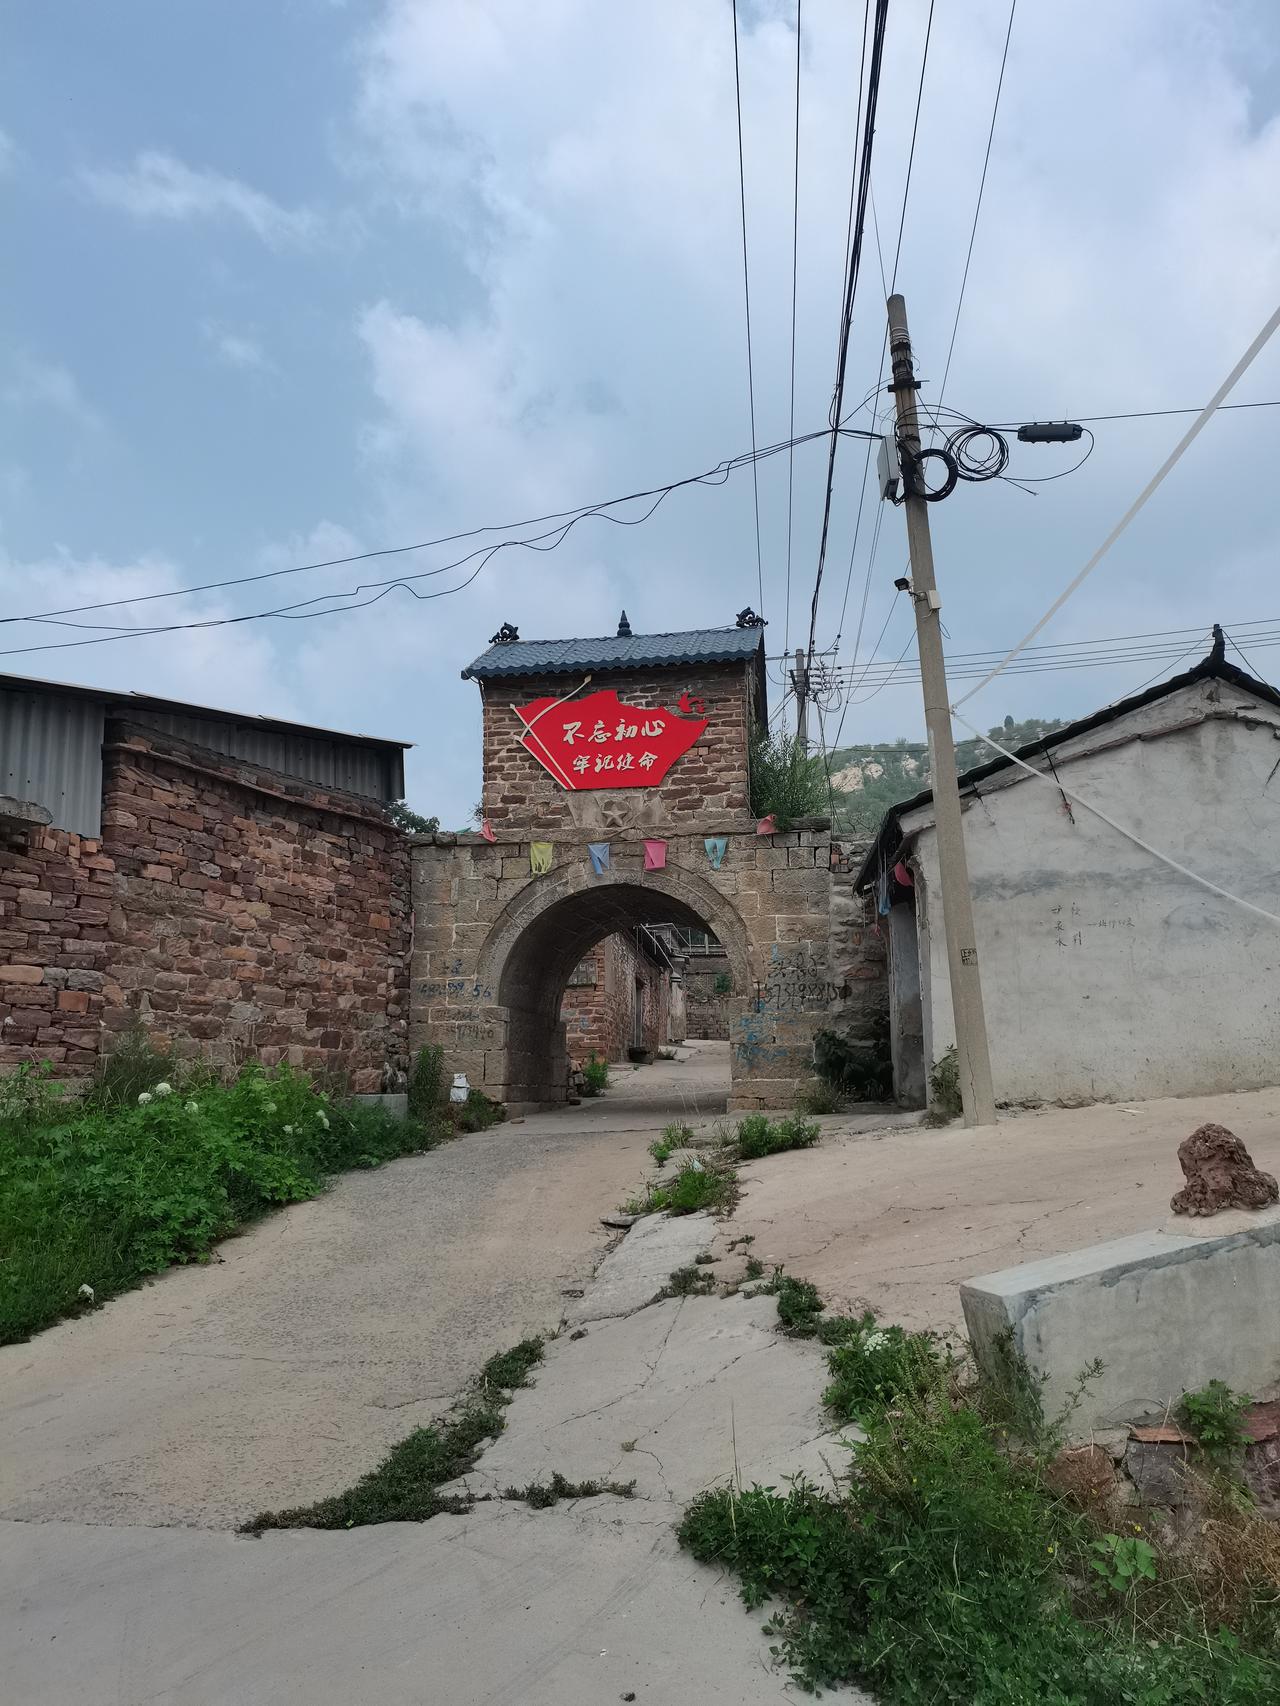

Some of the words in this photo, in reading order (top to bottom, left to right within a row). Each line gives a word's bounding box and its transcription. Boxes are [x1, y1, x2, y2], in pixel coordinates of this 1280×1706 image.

[563, 718, 666, 744] 不忘初心
[573, 751, 658, 774] 牢记使命
